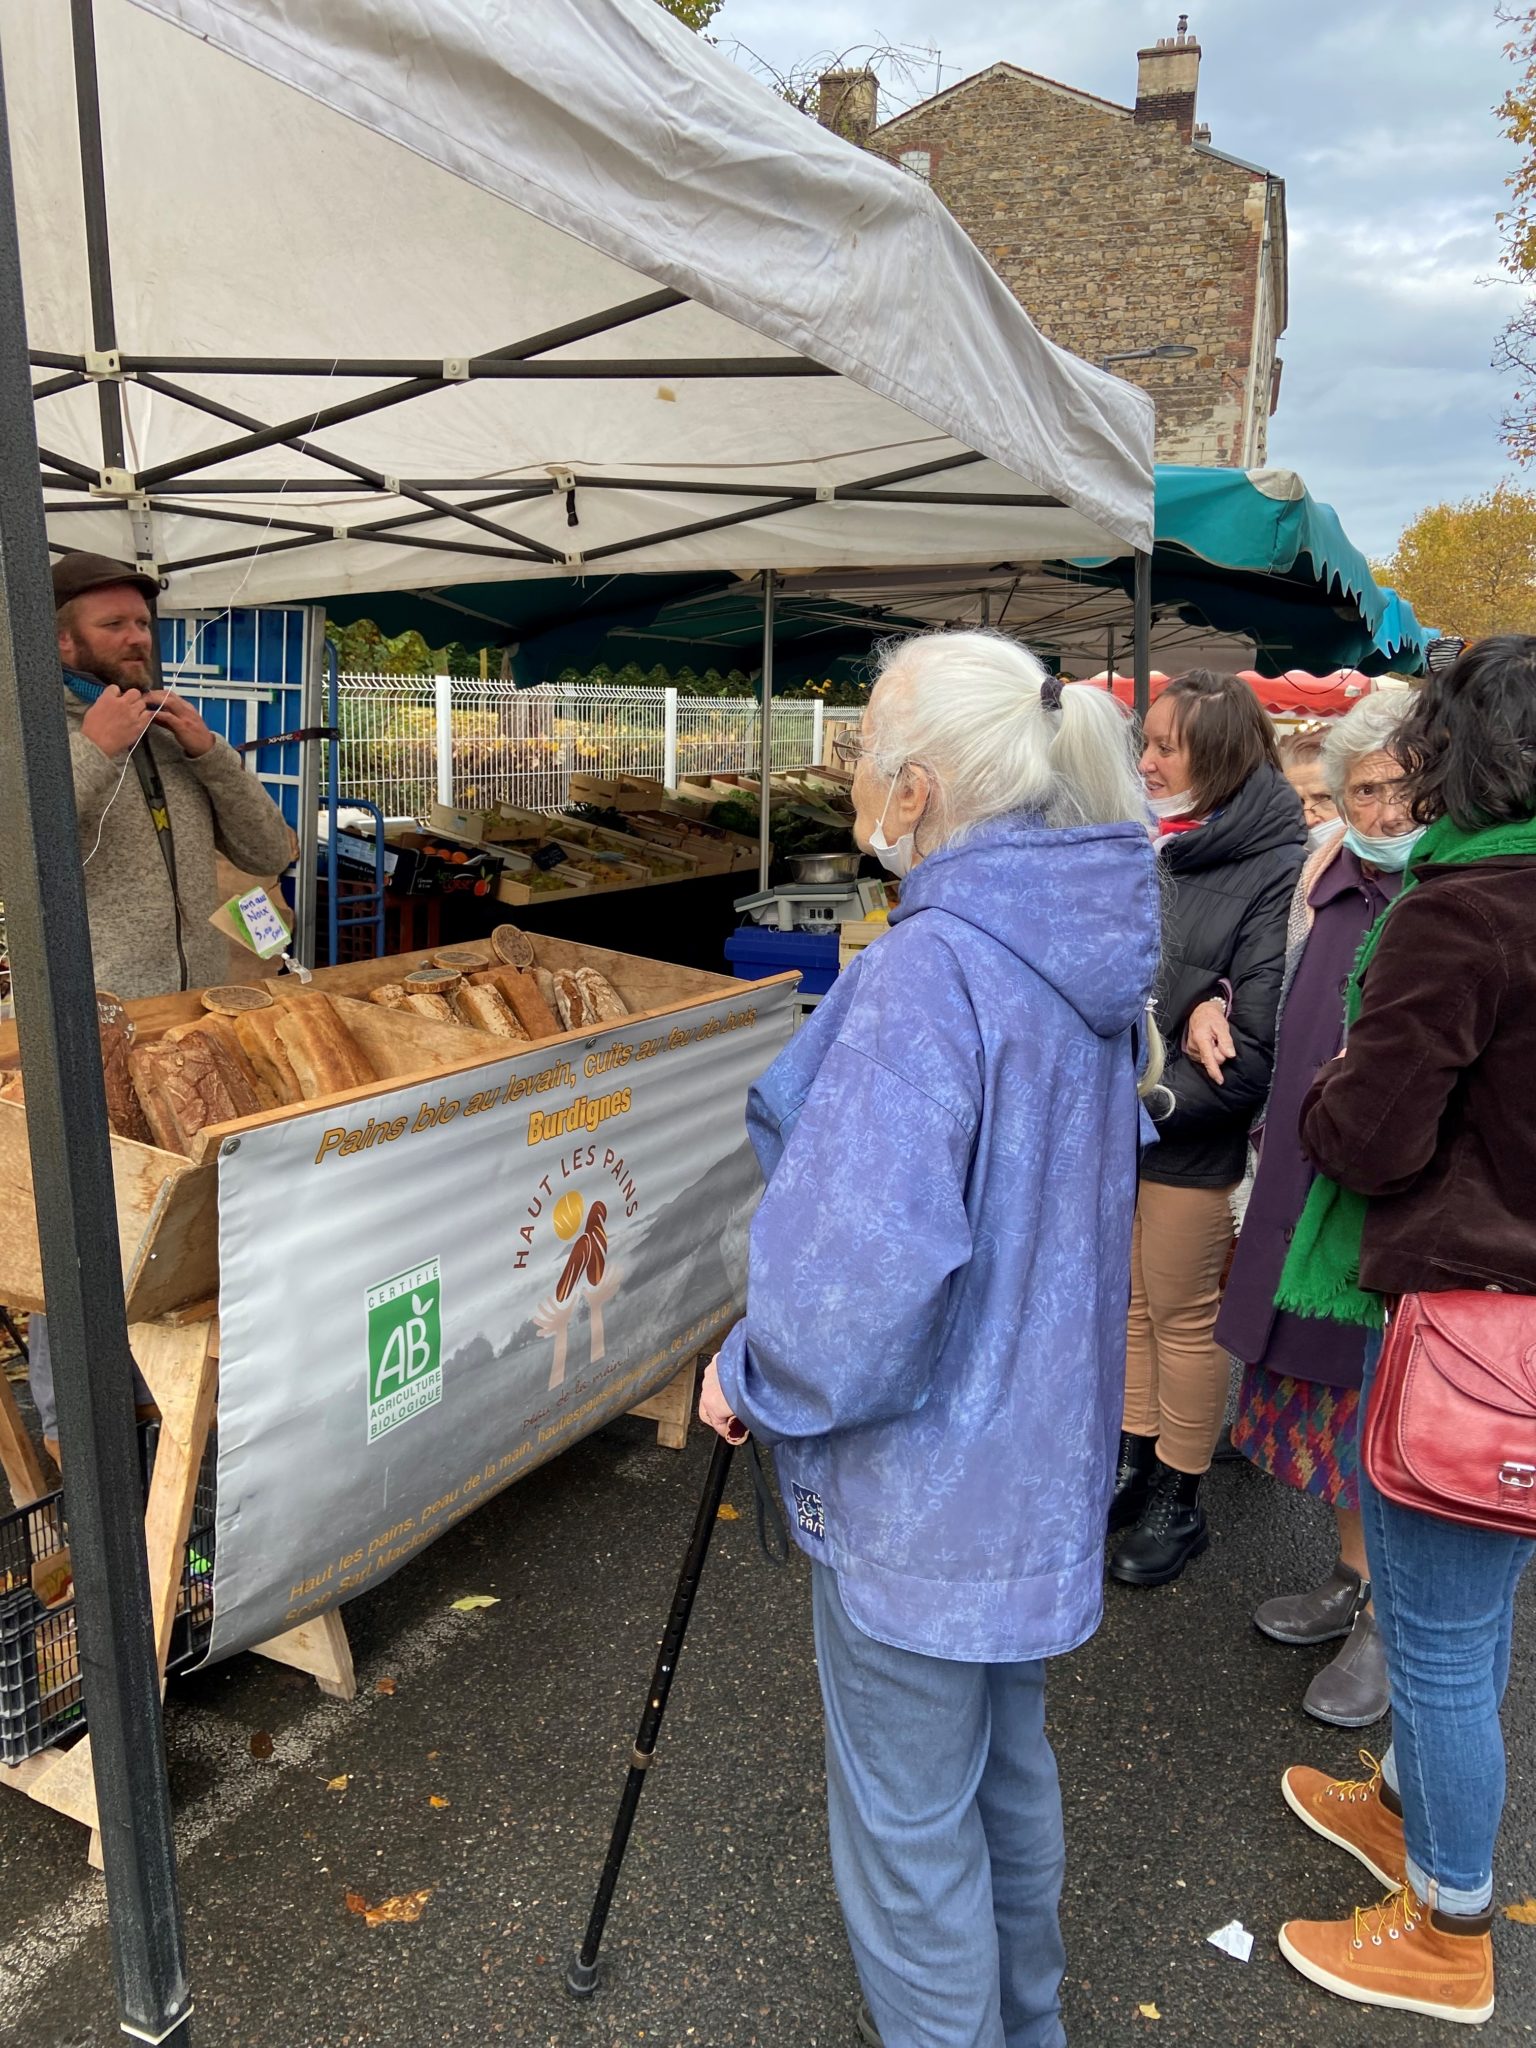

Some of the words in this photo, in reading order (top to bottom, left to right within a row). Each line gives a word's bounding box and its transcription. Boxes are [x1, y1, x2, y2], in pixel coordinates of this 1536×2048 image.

[315, 1118, 408, 1164] Pains
[410, 1097, 461, 1134] bio
[463, 1086, 502, 1117] au
[502, 1058, 577, 1105] levain,
[583, 1042, 634, 1078] cuits
[635, 1035, 664, 1061] au
[664, 1026, 697, 1052] feu
[696, 1015, 721, 1041] de
[527, 1087, 632, 1147] Burdignes
[513, 1174, 552, 1269] HAUT
[560, 1144, 596, 1178] LES
[603, 1148, 639, 1218] PAINS
[368, 1264, 439, 1309] CERTIFIÉ
[374, 1316, 431, 1398] AB
[369, 1371, 441, 1421] AGRICULTURE
[370, 1386, 441, 1436] BIOLOGIQUE
[290, 1563, 334, 1602] Haut
[338, 1546, 364, 1573] les
[420, 1489, 460, 1524] peau
[463, 1472, 481, 1496] de
[484, 1461, 497, 1481] la
